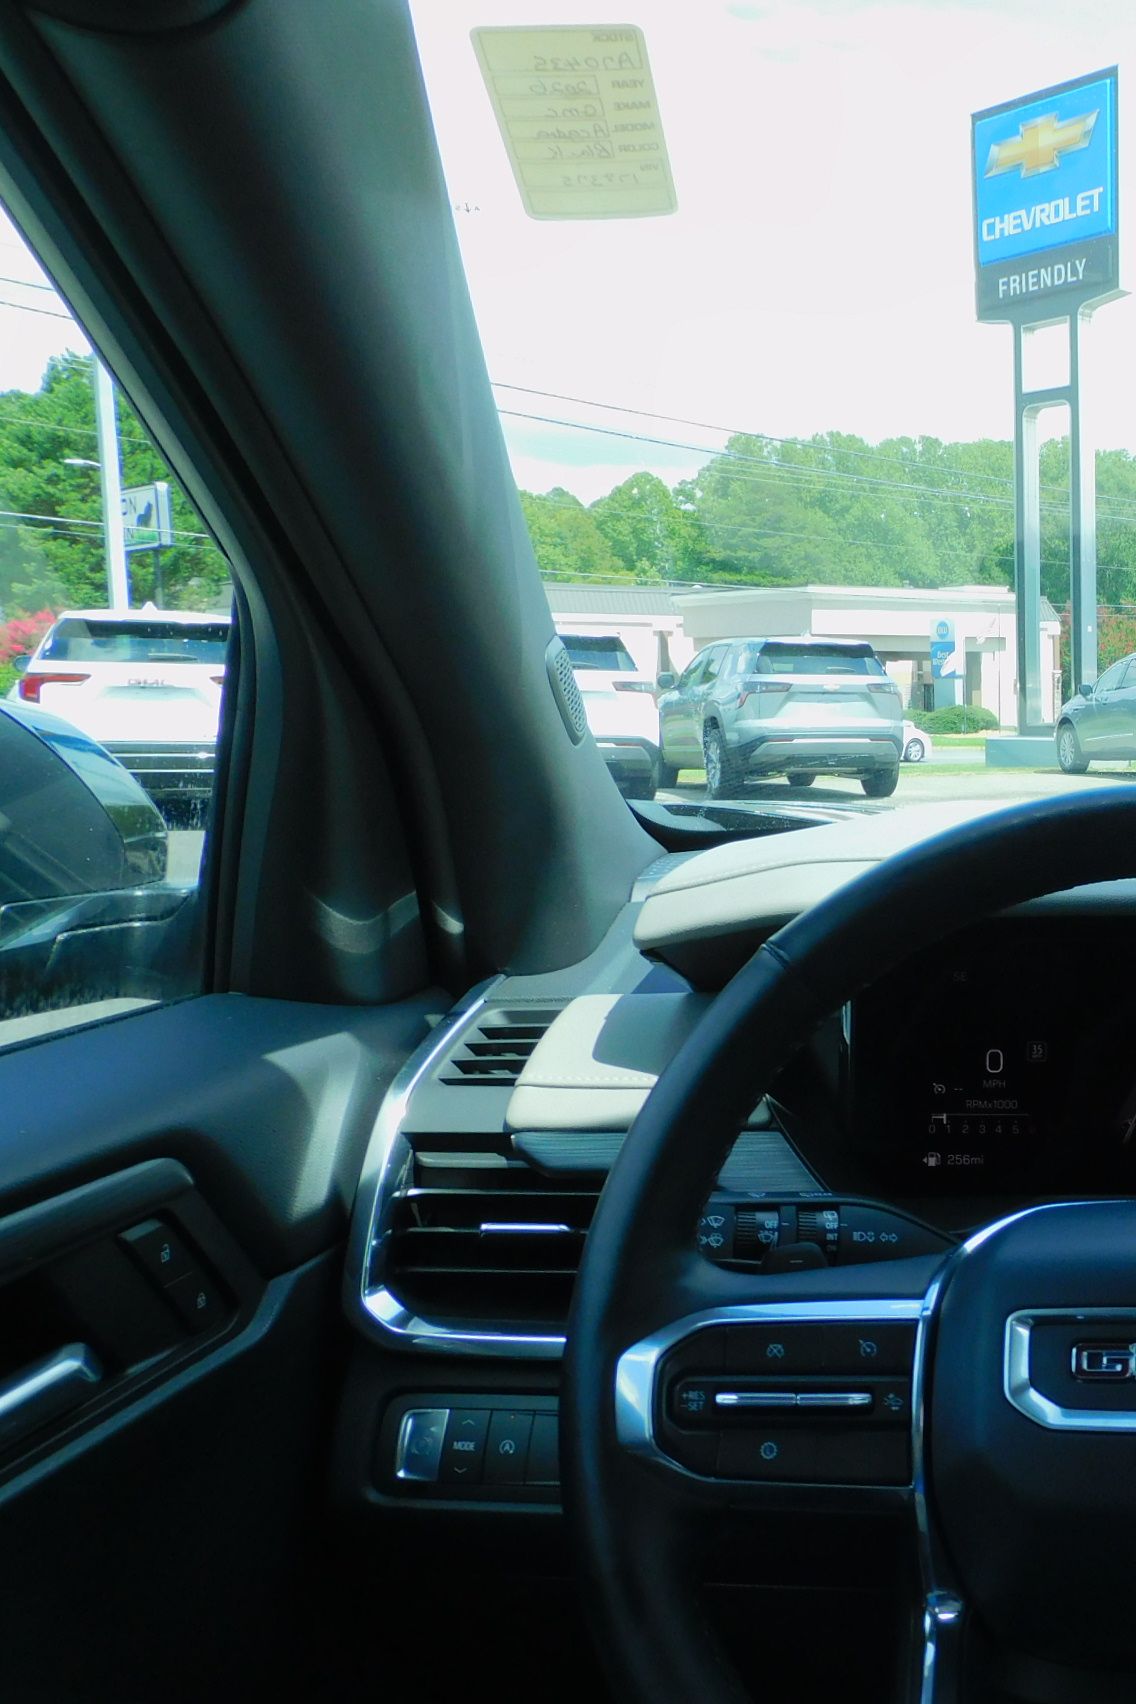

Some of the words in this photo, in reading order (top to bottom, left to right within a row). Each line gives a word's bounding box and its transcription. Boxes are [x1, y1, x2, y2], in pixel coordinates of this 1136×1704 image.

[981, 187, 1104, 242] CHEVROLET
[998, 258, 1087, 299] FRIENDLY
[982, 1079, 1006, 1089] MPH
[947, 1153, 985, 1166] 256mi
[452, 1440, 476, 1452] MODE
